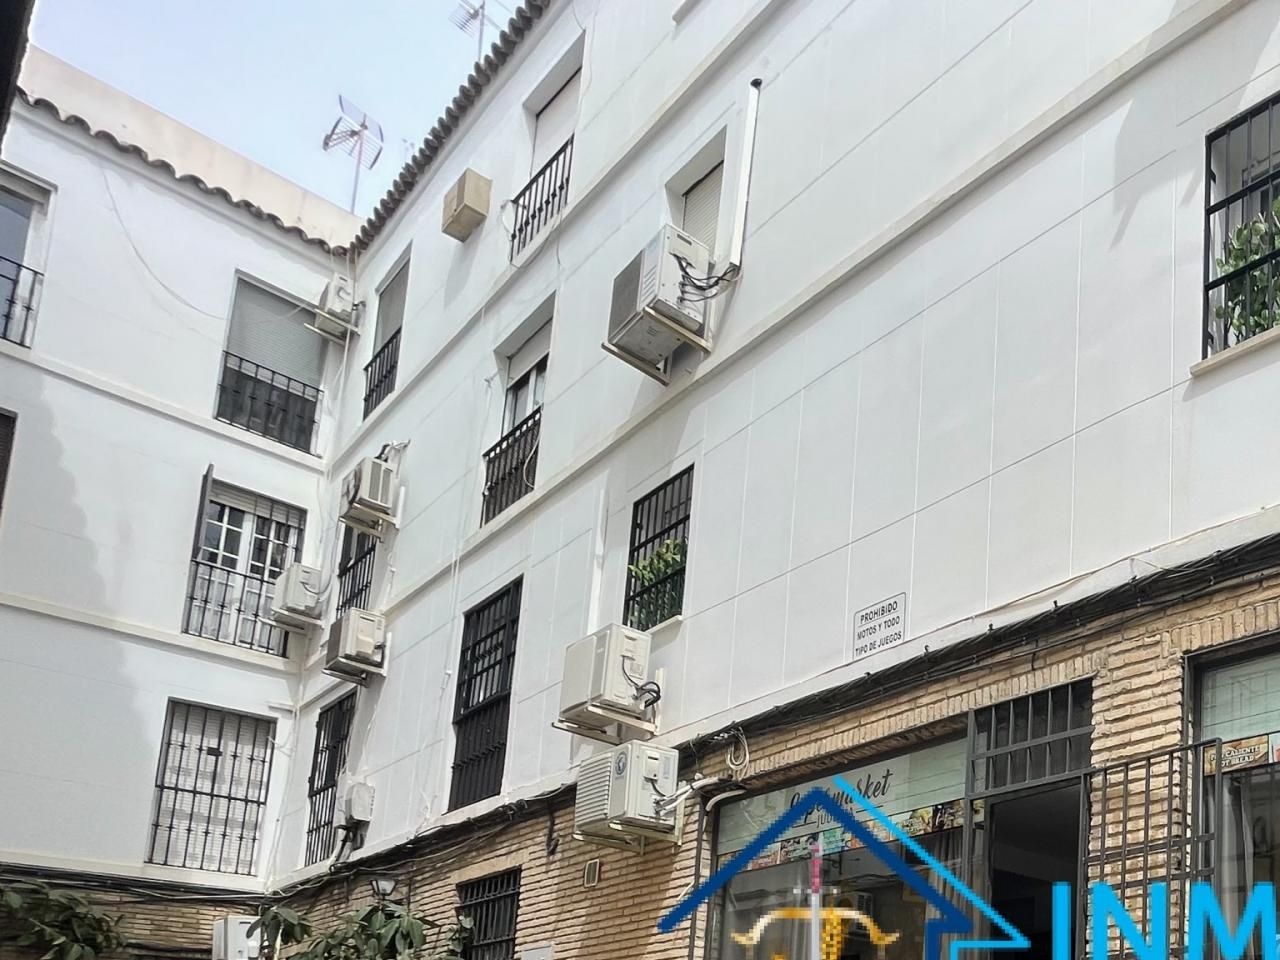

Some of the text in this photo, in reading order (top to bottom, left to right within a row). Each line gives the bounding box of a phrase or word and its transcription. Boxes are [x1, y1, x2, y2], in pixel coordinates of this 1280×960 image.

[860, 600, 898, 625] PROHIBIDO
[857, 615, 900, 641] MOTOS Y TODO
[855, 631, 902, 657] TIPO DE JUEGOS
[1225, 746, 1260, 757] CALIENTE
[1230, 754, 1254, 765] BREAD
